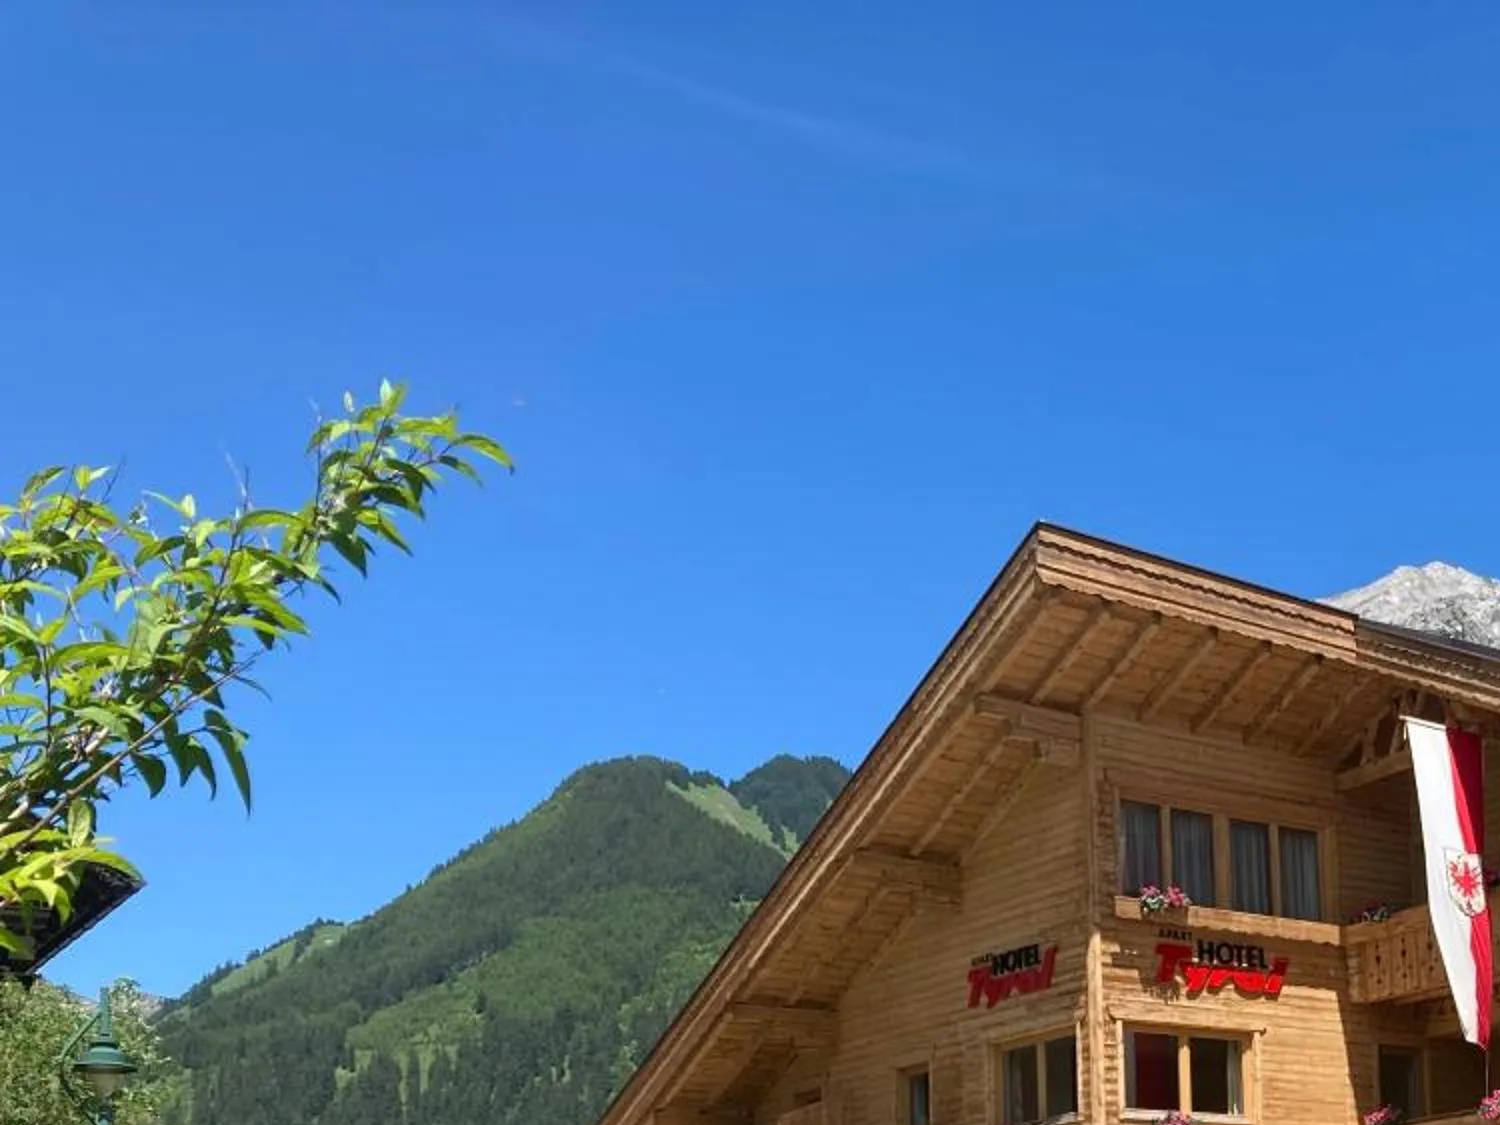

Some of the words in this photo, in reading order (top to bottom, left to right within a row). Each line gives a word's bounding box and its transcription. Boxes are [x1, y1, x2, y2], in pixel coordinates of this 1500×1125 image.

[992, 944, 1041, 977] HOTEL
[1155, 942, 1289, 997] Tyrol
[1196, 939, 1269, 969] HOTEL
[967, 945, 1059, 1009] Tyrol
